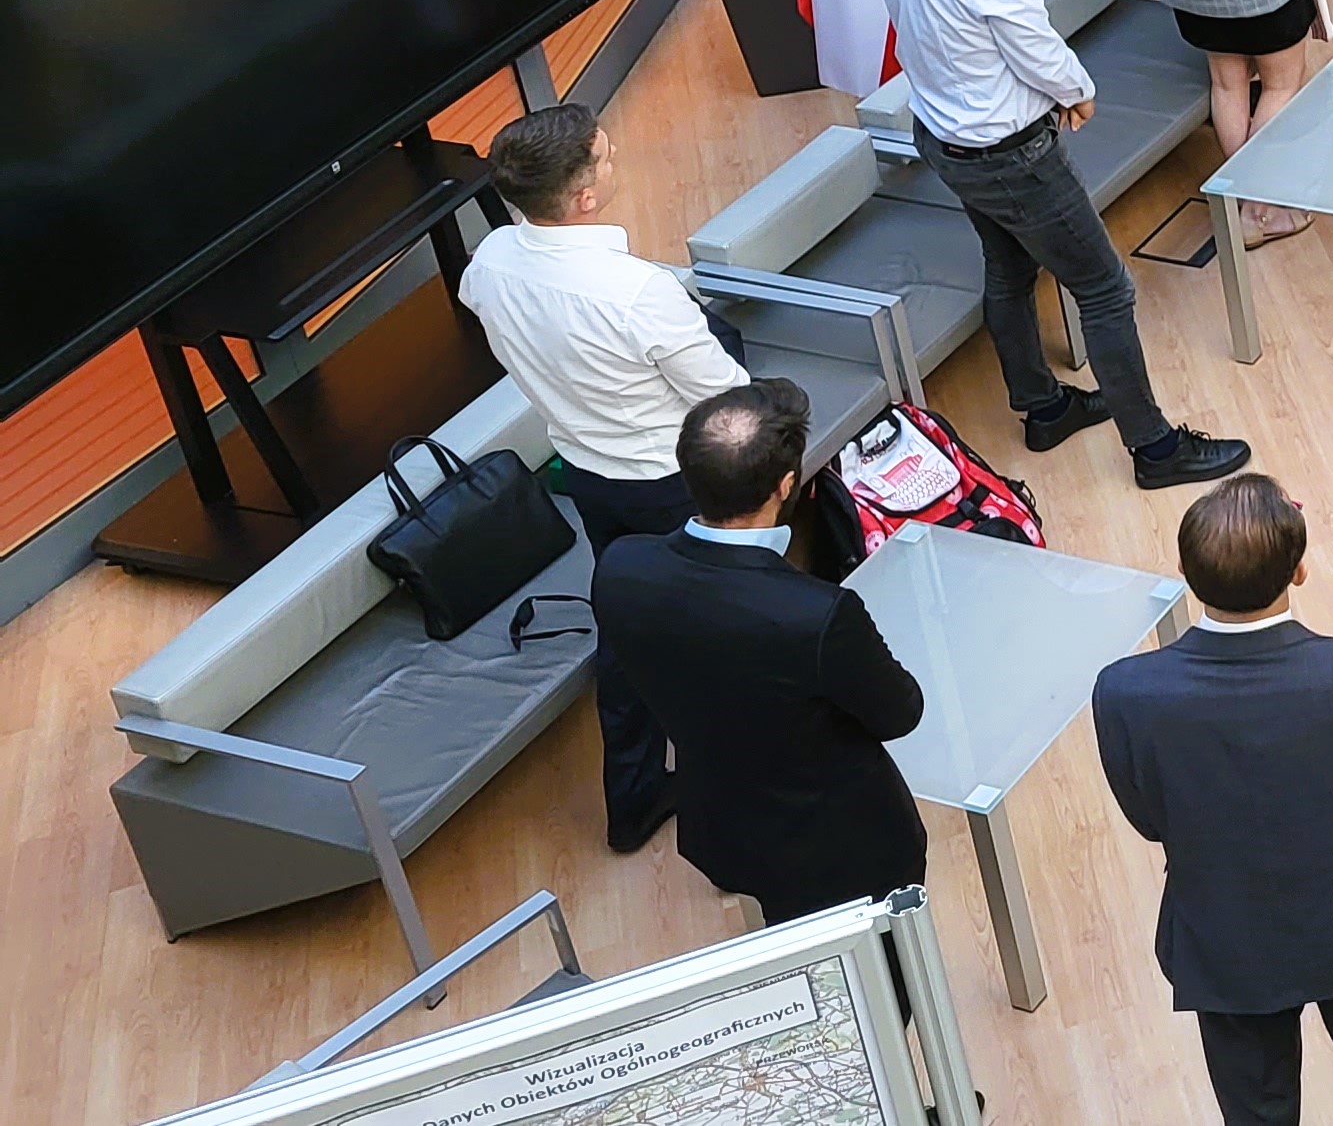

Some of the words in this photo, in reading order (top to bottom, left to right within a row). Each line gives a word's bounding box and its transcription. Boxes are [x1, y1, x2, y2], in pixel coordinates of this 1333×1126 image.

[501, 1076, 595, 1108] Obiektów
[601, 1001, 805, 1079] Ogólnogeograficznych
[525, 1042, 645, 1085] Wizualizacja
